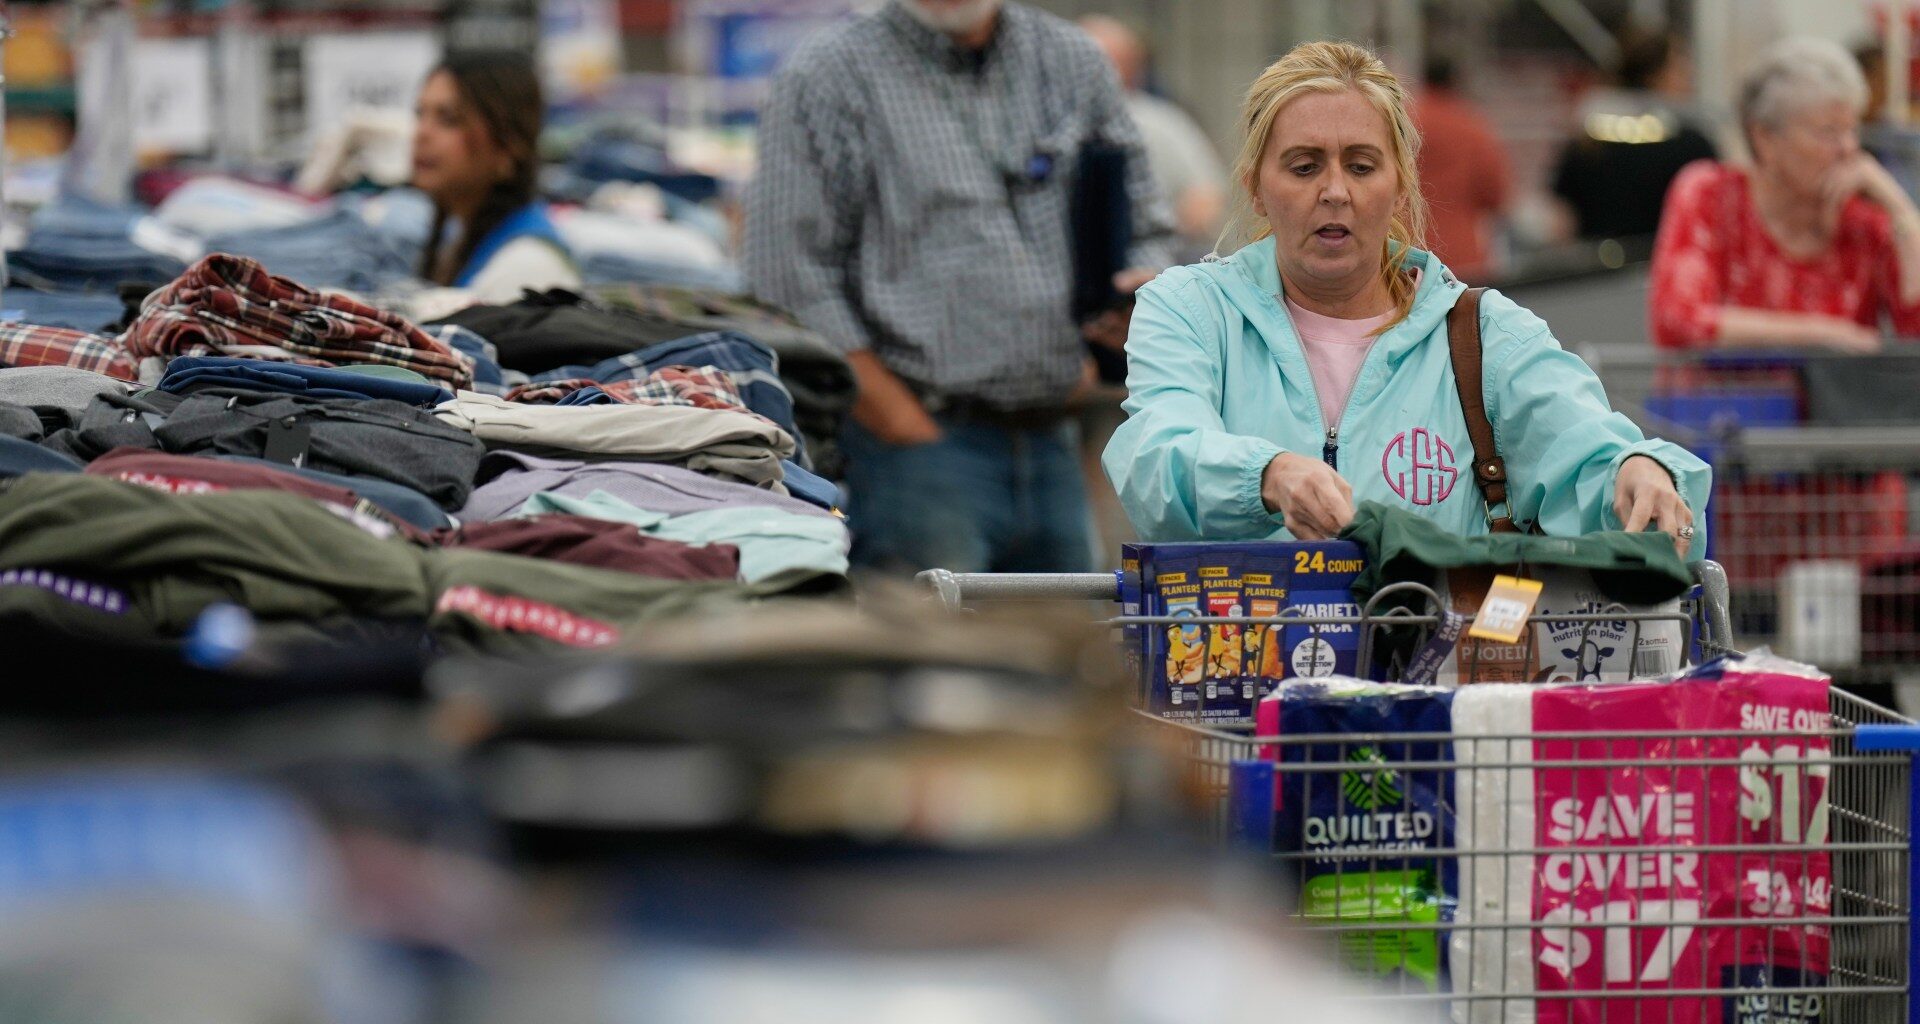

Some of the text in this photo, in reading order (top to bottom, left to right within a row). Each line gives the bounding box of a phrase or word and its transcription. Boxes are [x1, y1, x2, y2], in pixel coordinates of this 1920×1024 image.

[1382, 427, 1458, 505] CES
[1294, 550, 1364, 574] 24 COUNT
[1161, 584, 1200, 596] PLANTERS
[1203, 579, 1242, 589] PLANTERS
[1245, 587, 1285, 598] PLANTERS
[1294, 603, 1363, 619] VARIETY
[1552, 629, 1622, 643] nutriton plan
[1741, 703, 1790, 731] SAVE
[1740, 741, 1831, 846] $17
[1304, 811, 1434, 845] QUILTED
[1549, 793, 1694, 841] SAVE
[1544, 852, 1699, 893] OVER
[1540, 899, 1700, 983] $17
